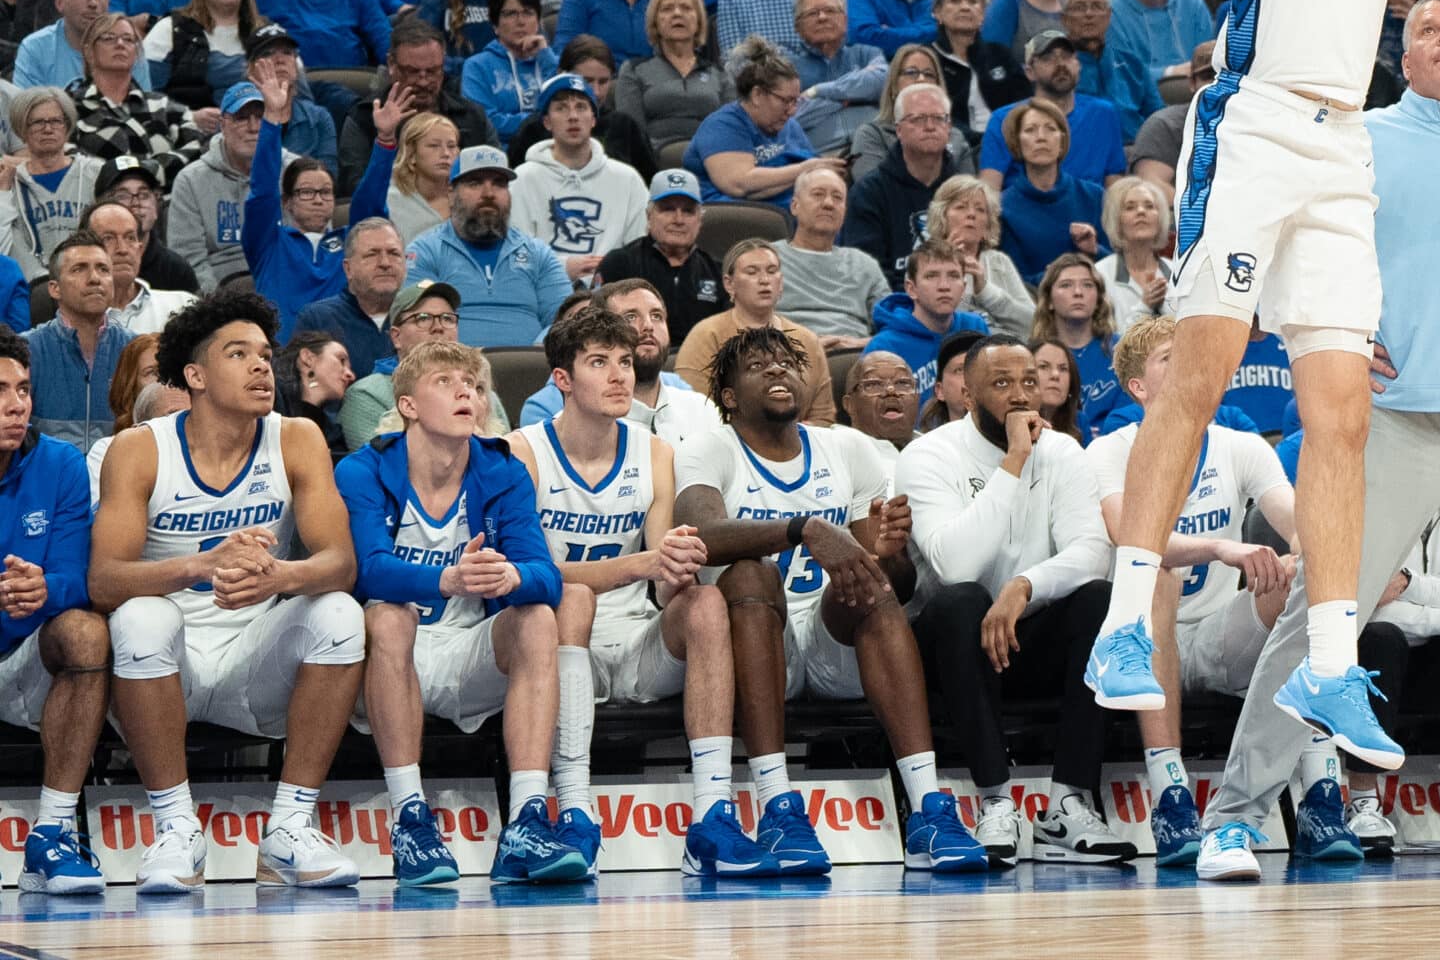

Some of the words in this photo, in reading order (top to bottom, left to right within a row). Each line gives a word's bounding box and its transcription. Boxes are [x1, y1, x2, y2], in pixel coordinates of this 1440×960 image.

[1226, 365, 1293, 392] EIGHTO
[154, 501, 285, 531] CREIGHTON
[540, 508, 645, 534] CREIGHTON
[1174, 507, 1231, 535] GHTON
[394, 542, 468, 567] REIGH
[547, 794, 693, 839] Vee
[733, 789, 886, 835] Vee
[100, 803, 272, 853] Hee
[317, 800, 489, 857] Hyee
